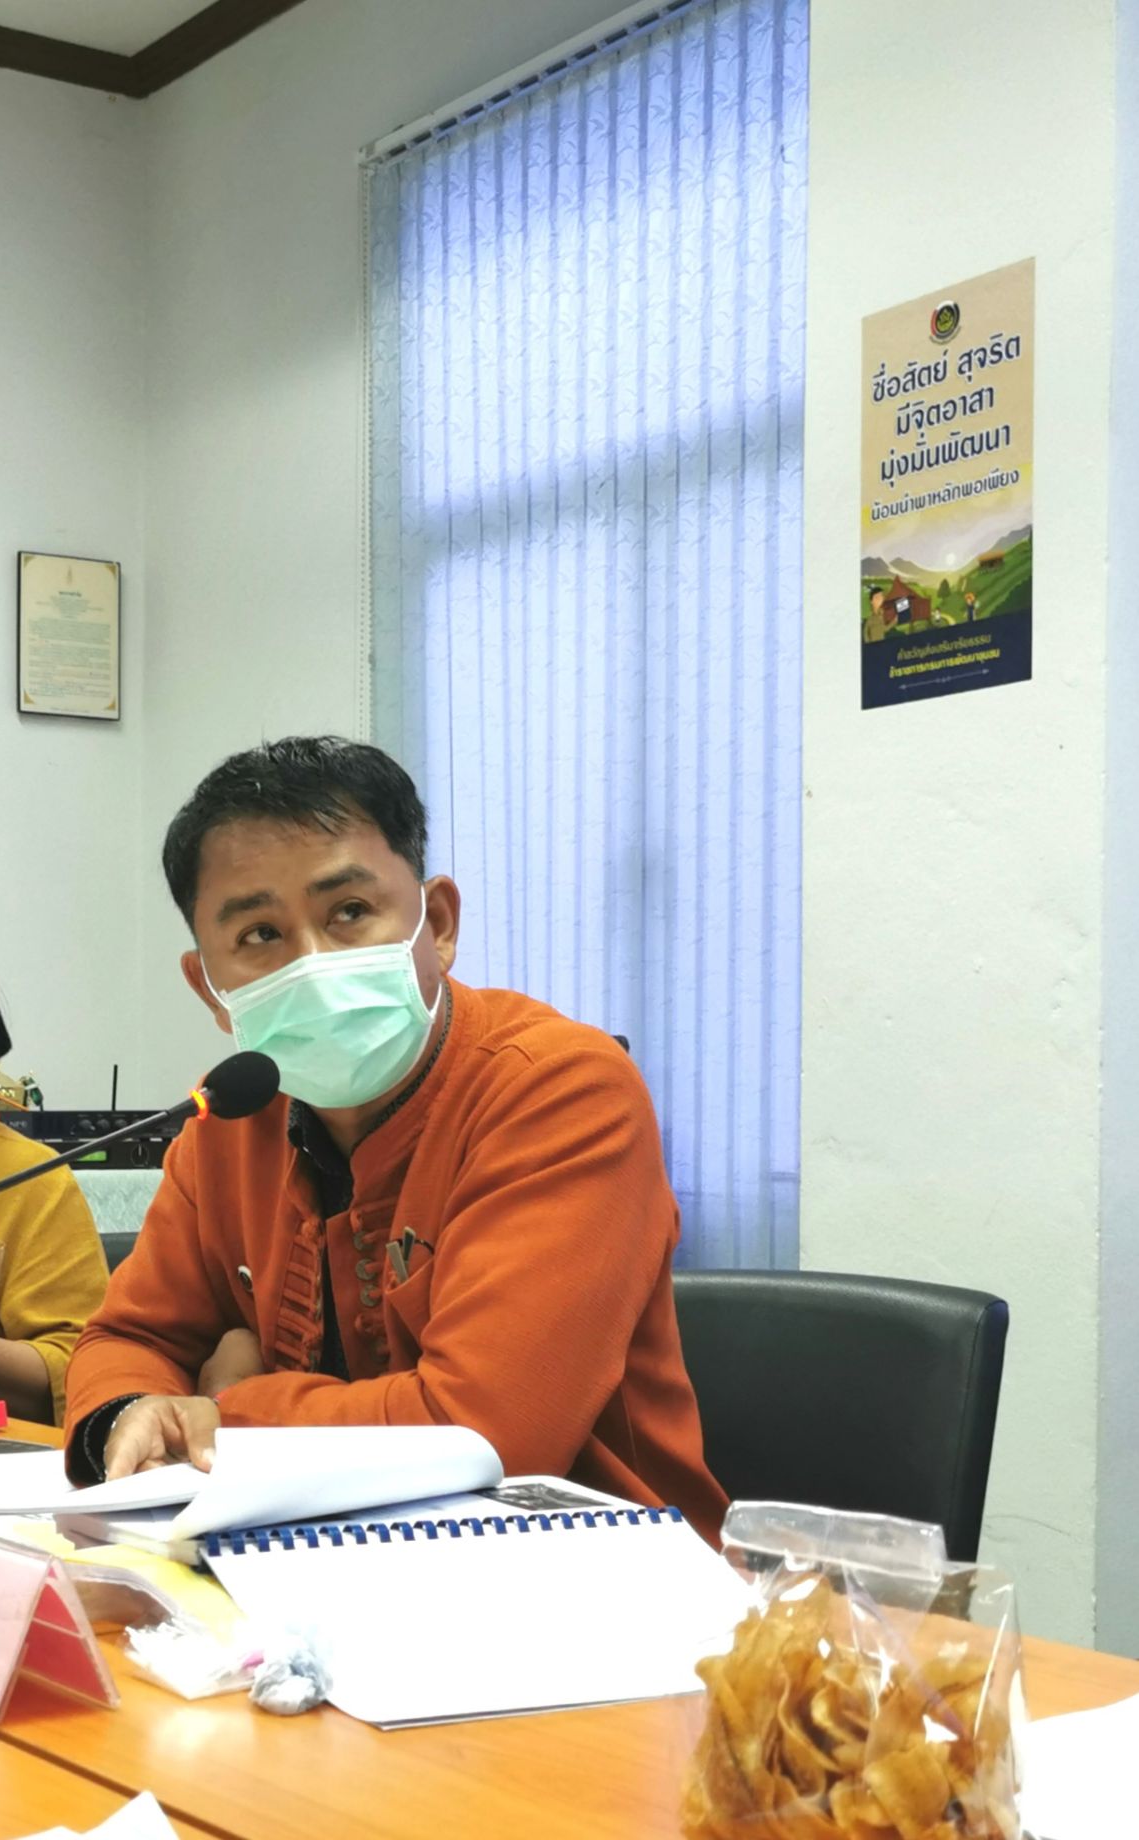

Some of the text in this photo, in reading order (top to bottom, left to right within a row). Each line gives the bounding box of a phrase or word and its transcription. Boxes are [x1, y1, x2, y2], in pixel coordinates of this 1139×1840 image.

[873, 333, 1021, 402] ซื่อสัตย์ สุจริต
[896, 387, 994, 436] มีจิตอาสา
[880, 425, 1010, 488] มุ่งมั่นพัฒนา
[871, 468, 1020, 521] น้อมนำพาหลักพอเพียง
